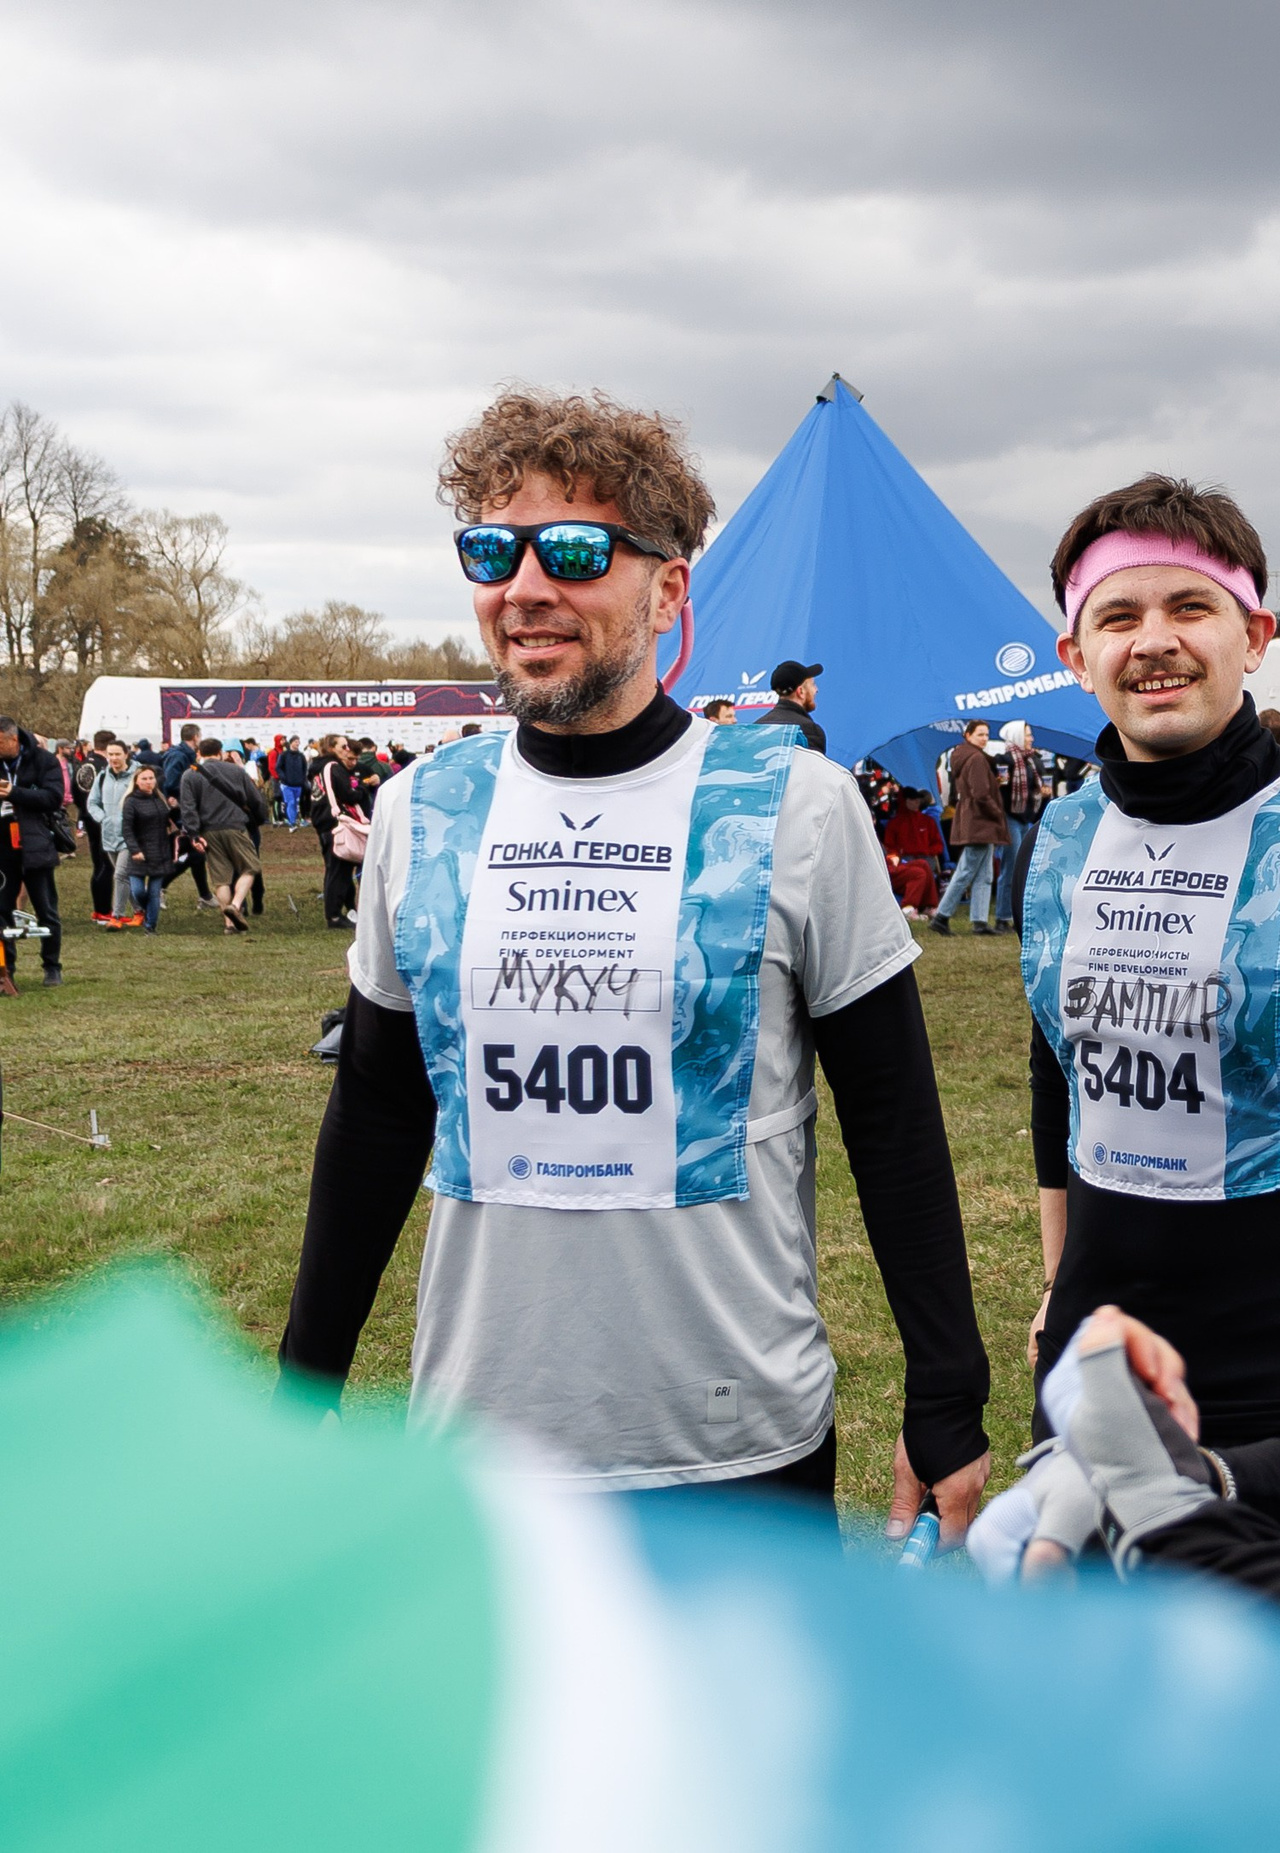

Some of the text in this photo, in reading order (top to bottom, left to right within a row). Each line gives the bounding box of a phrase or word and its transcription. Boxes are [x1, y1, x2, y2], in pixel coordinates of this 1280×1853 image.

[279, 691, 417, 708] ГОНКА ГЕРОЕВ
[489, 841, 673, 864] ГОНКА ГЕРОЕВ
[1085, 869, 1229, 891] ГОНКА ГЕРОЕВ
[505, 880, 638, 912] Sminex
[1095, 902, 1196, 935] Sminex
[501, 931, 636, 942] ПЕРФЕКЦИОНИСТЫ
[499, 948, 634, 958] FINE DEVELOPMENT
[1089, 947, 1190, 960] ПЕРФЕКЦИОНИСТЫ
[1088, 962, 1188, 976] FINE DEVELOPMENT
[483, 1044, 653, 1114] 5400
[1080, 1039, 1206, 1114] 5404
[536, 1162, 634, 1178] ГАЗПРОМБАНК
[1110, 1150, 1187, 1171] ГАЗПРОМБАНК
